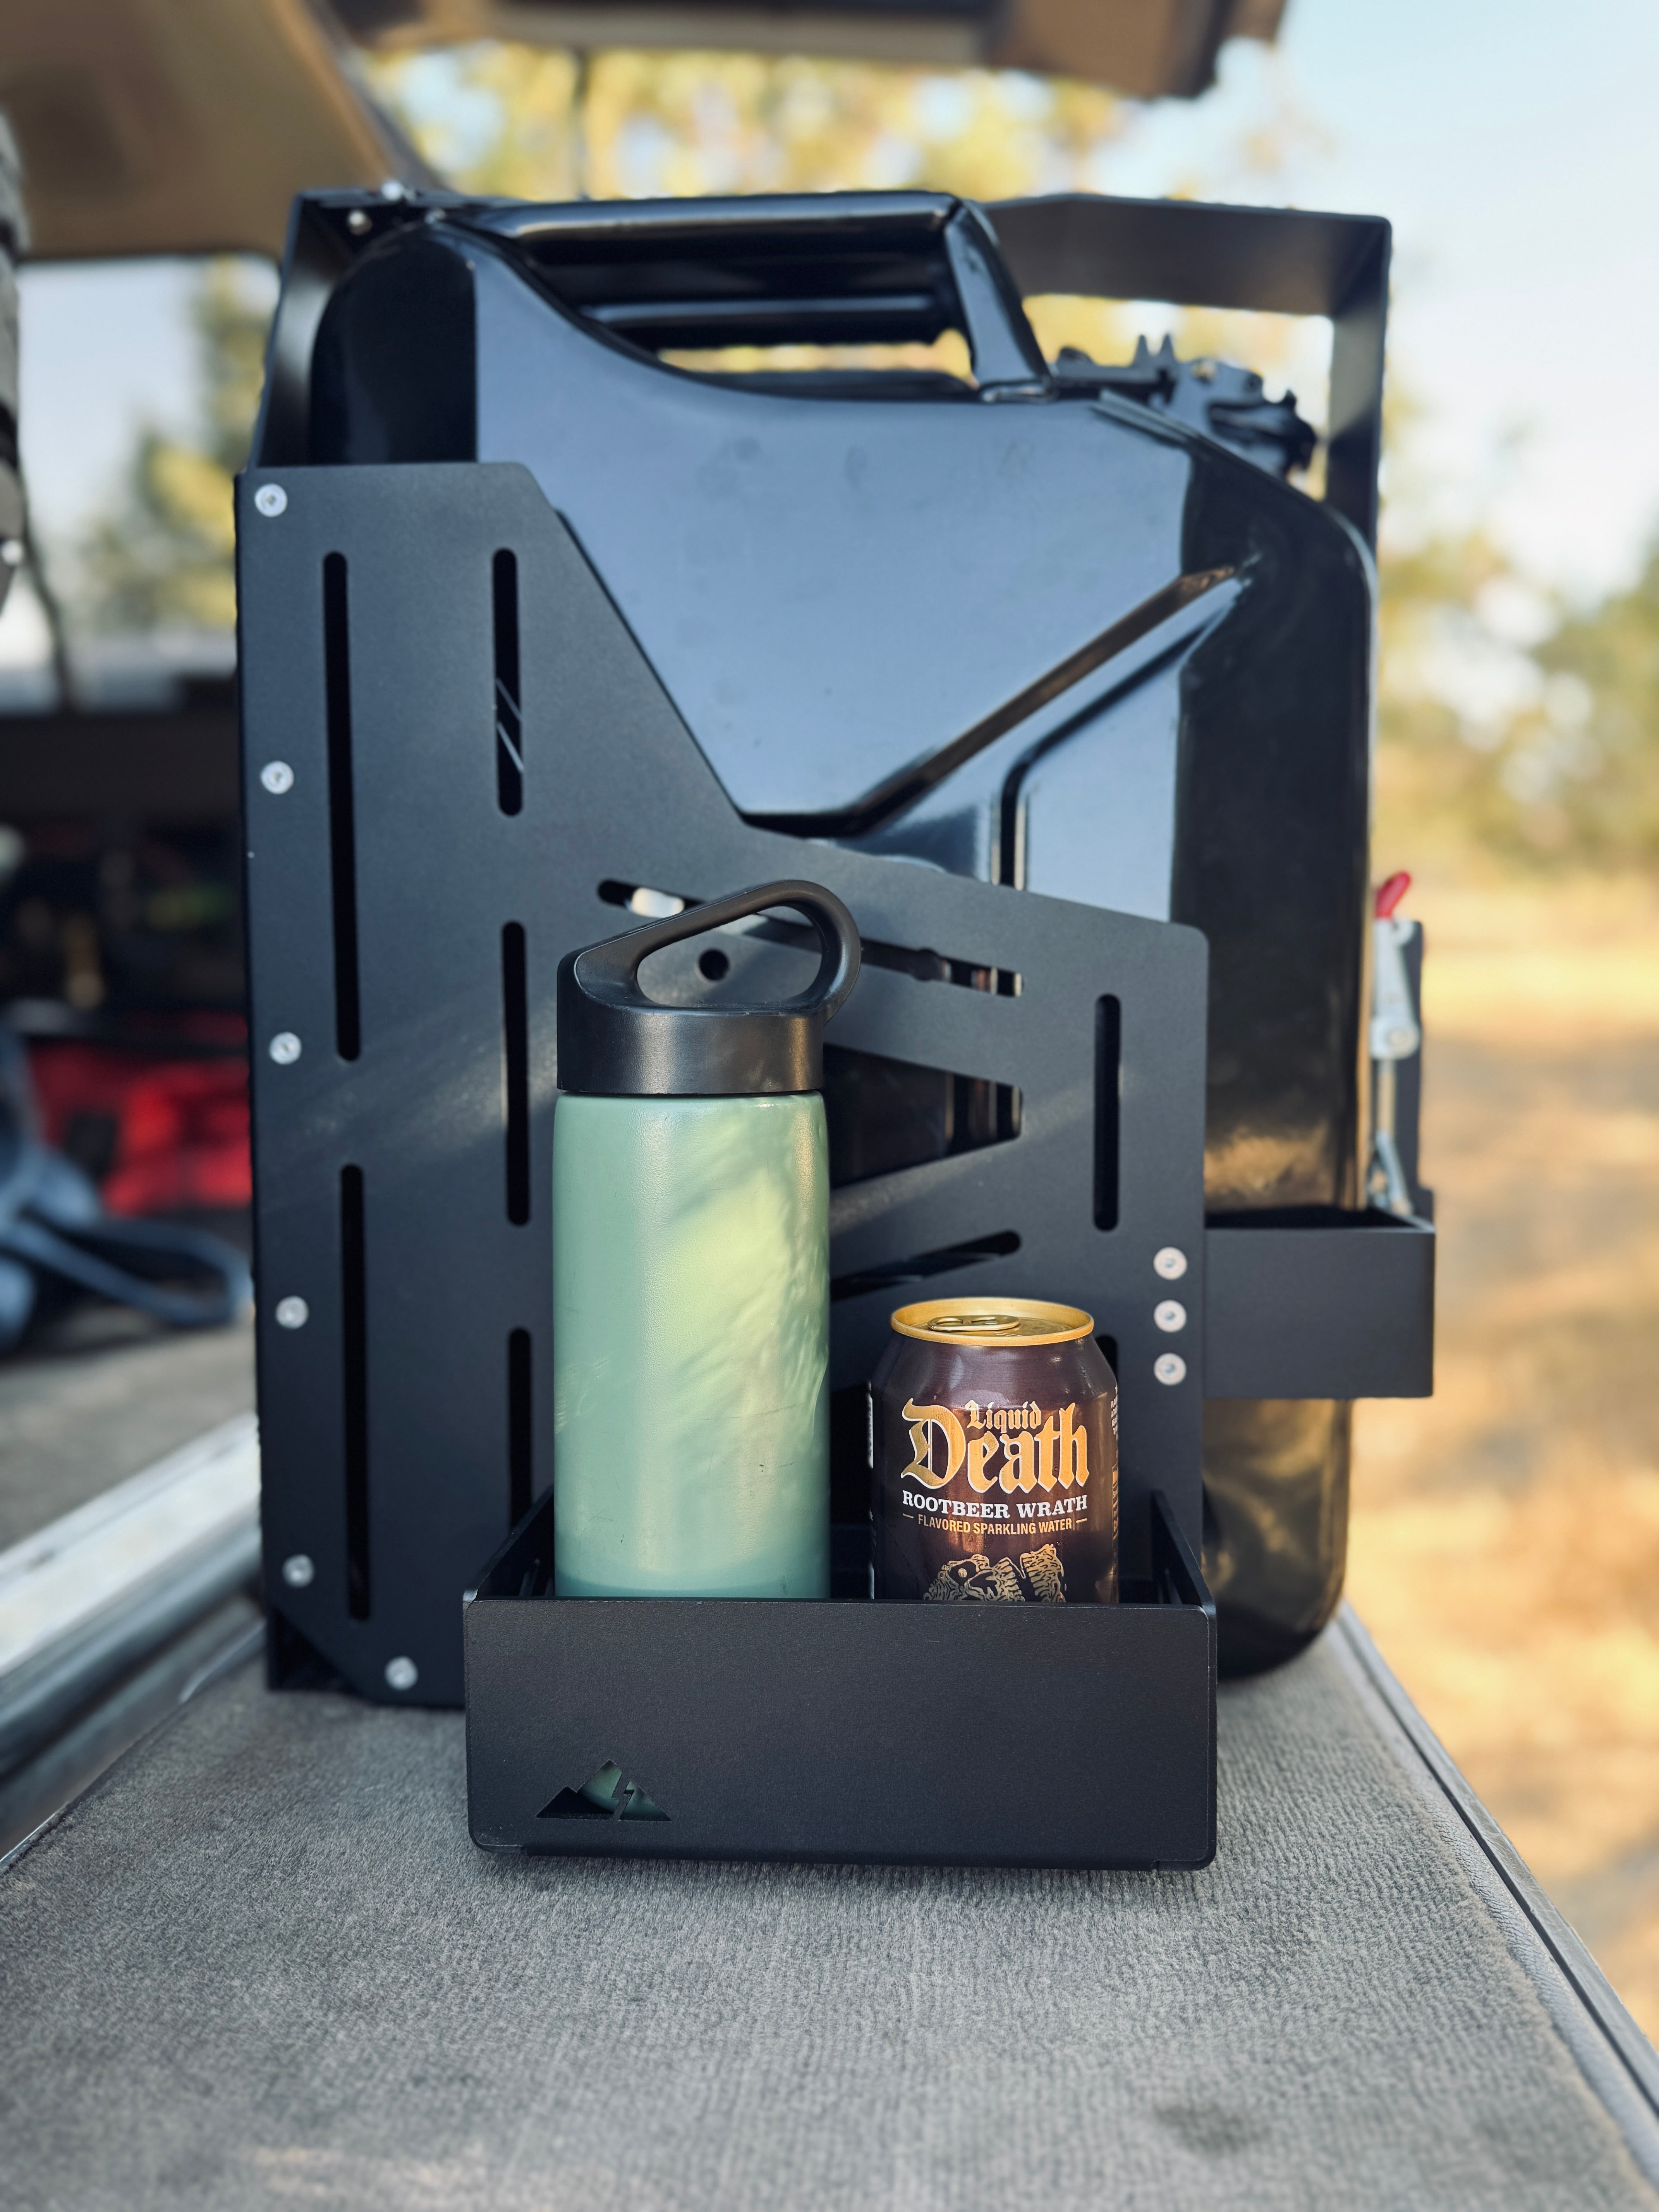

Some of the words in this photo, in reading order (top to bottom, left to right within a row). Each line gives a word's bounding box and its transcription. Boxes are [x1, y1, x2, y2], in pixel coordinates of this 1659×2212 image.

[965, 1400, 1041, 1434] Liquid
[901, 1398, 1089, 1494] Death
[903, 1490, 1010, 1518] ROOTBEER
[1016, 1495, 1087, 1518] WRATH
[918, 1514, 970, 1534] FLAVORED
[973, 1522, 1036, 1535] SPARKLING
[1039, 1518, 1072, 1534] WATER
